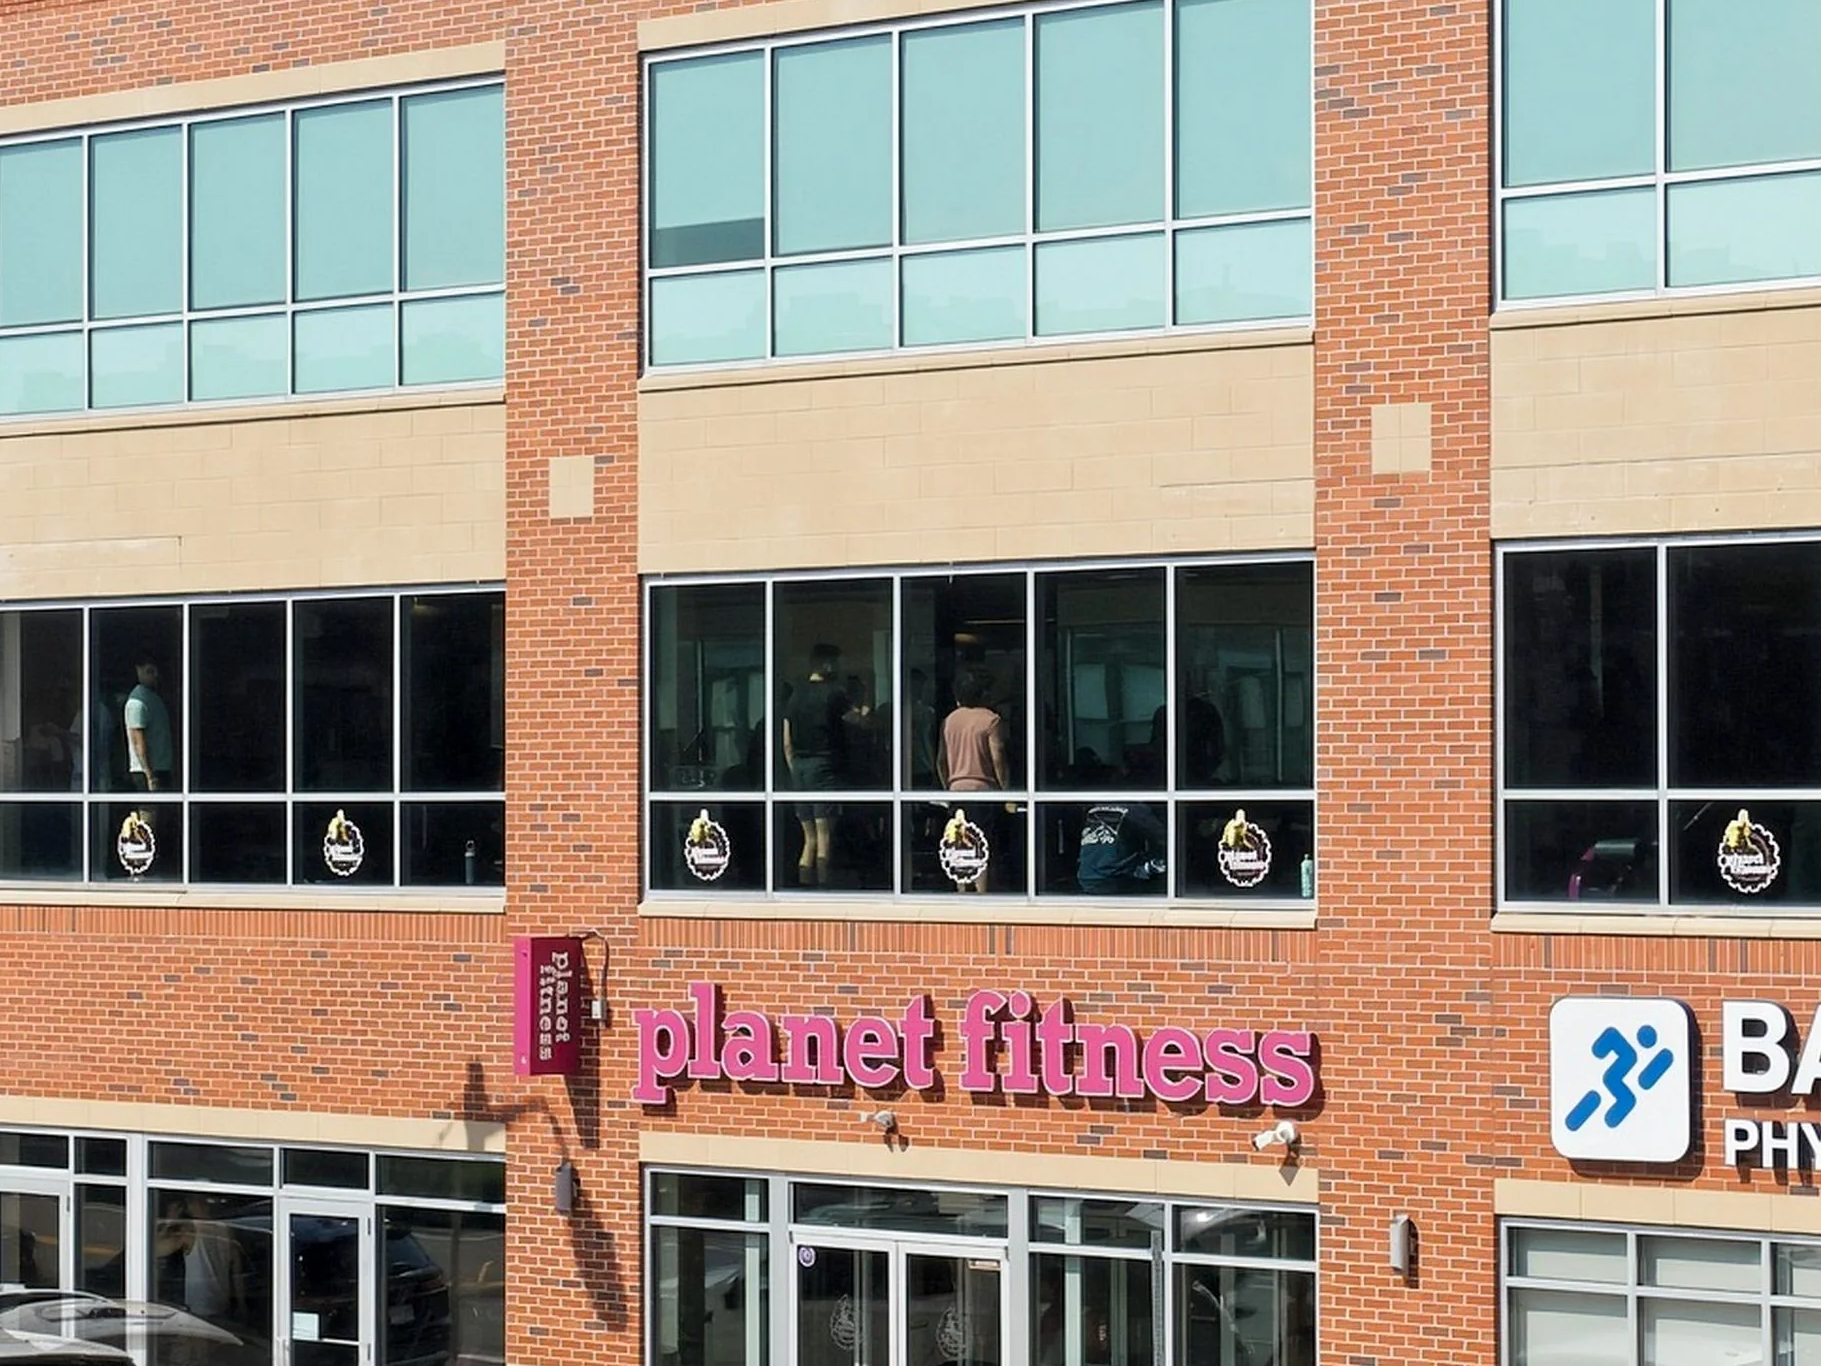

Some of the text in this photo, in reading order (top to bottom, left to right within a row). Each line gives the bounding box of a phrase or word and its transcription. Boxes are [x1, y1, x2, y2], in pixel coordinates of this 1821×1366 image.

[539, 964, 557, 1060] fitness
[552, 951, 573, 1043] planet
[632, 982, 1313, 1106] planet fitness
